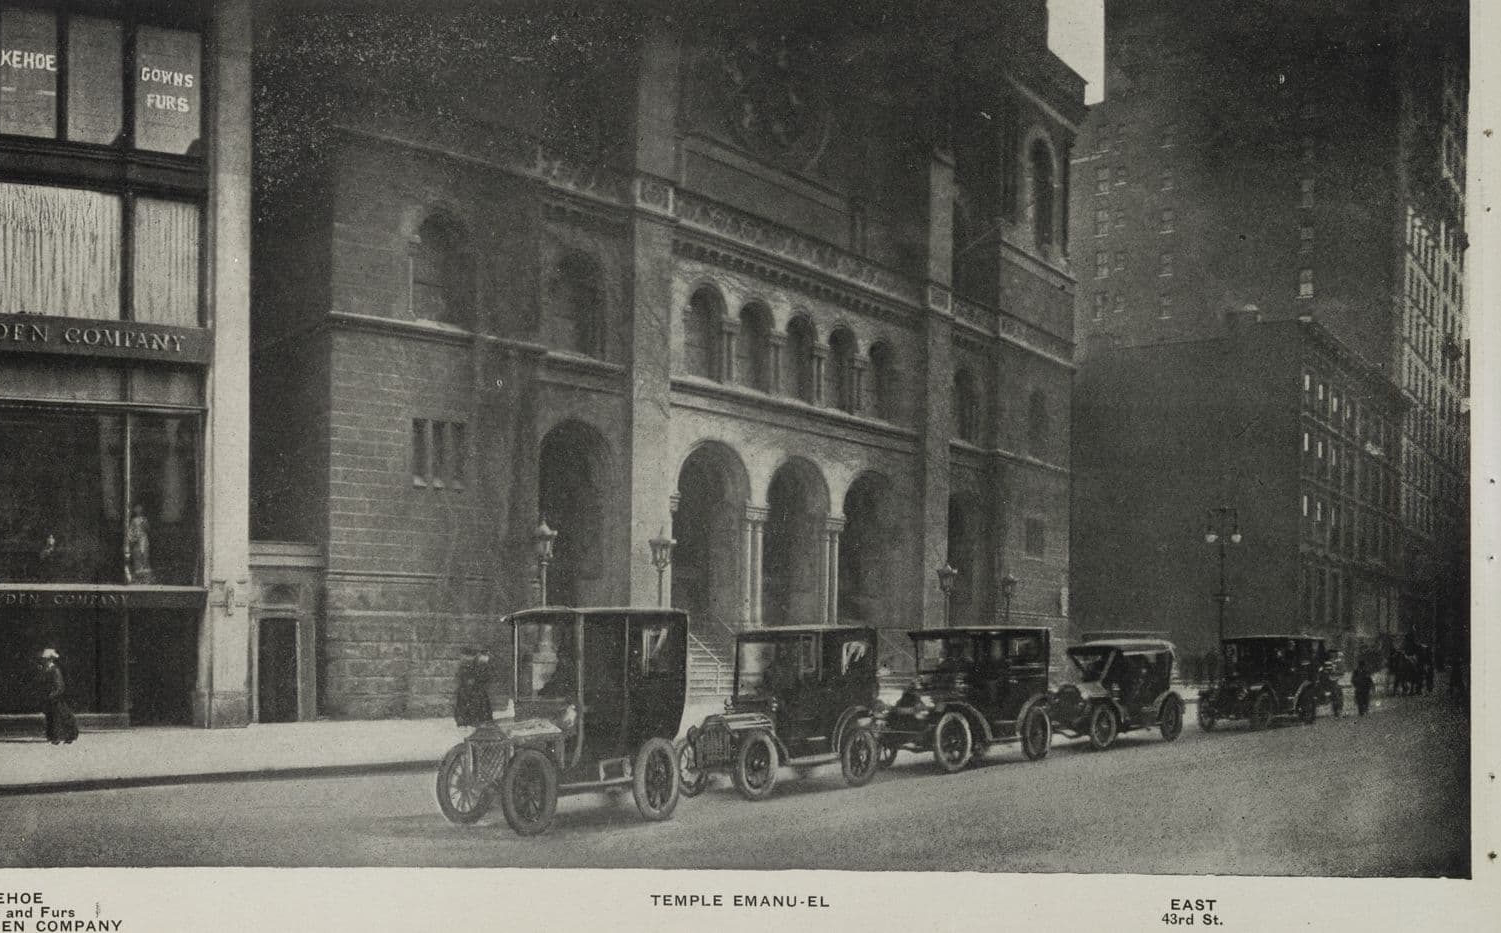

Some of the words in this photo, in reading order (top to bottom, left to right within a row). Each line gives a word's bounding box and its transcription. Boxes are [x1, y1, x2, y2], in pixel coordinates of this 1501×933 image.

[0, 50, 57, 71] KEHOE
[140, 66, 194, 88] GOWNS
[146, 94, 190, 112] FURS
[63, 326, 187, 351] COMPANY
[53, 593, 130, 606] COMPANY
